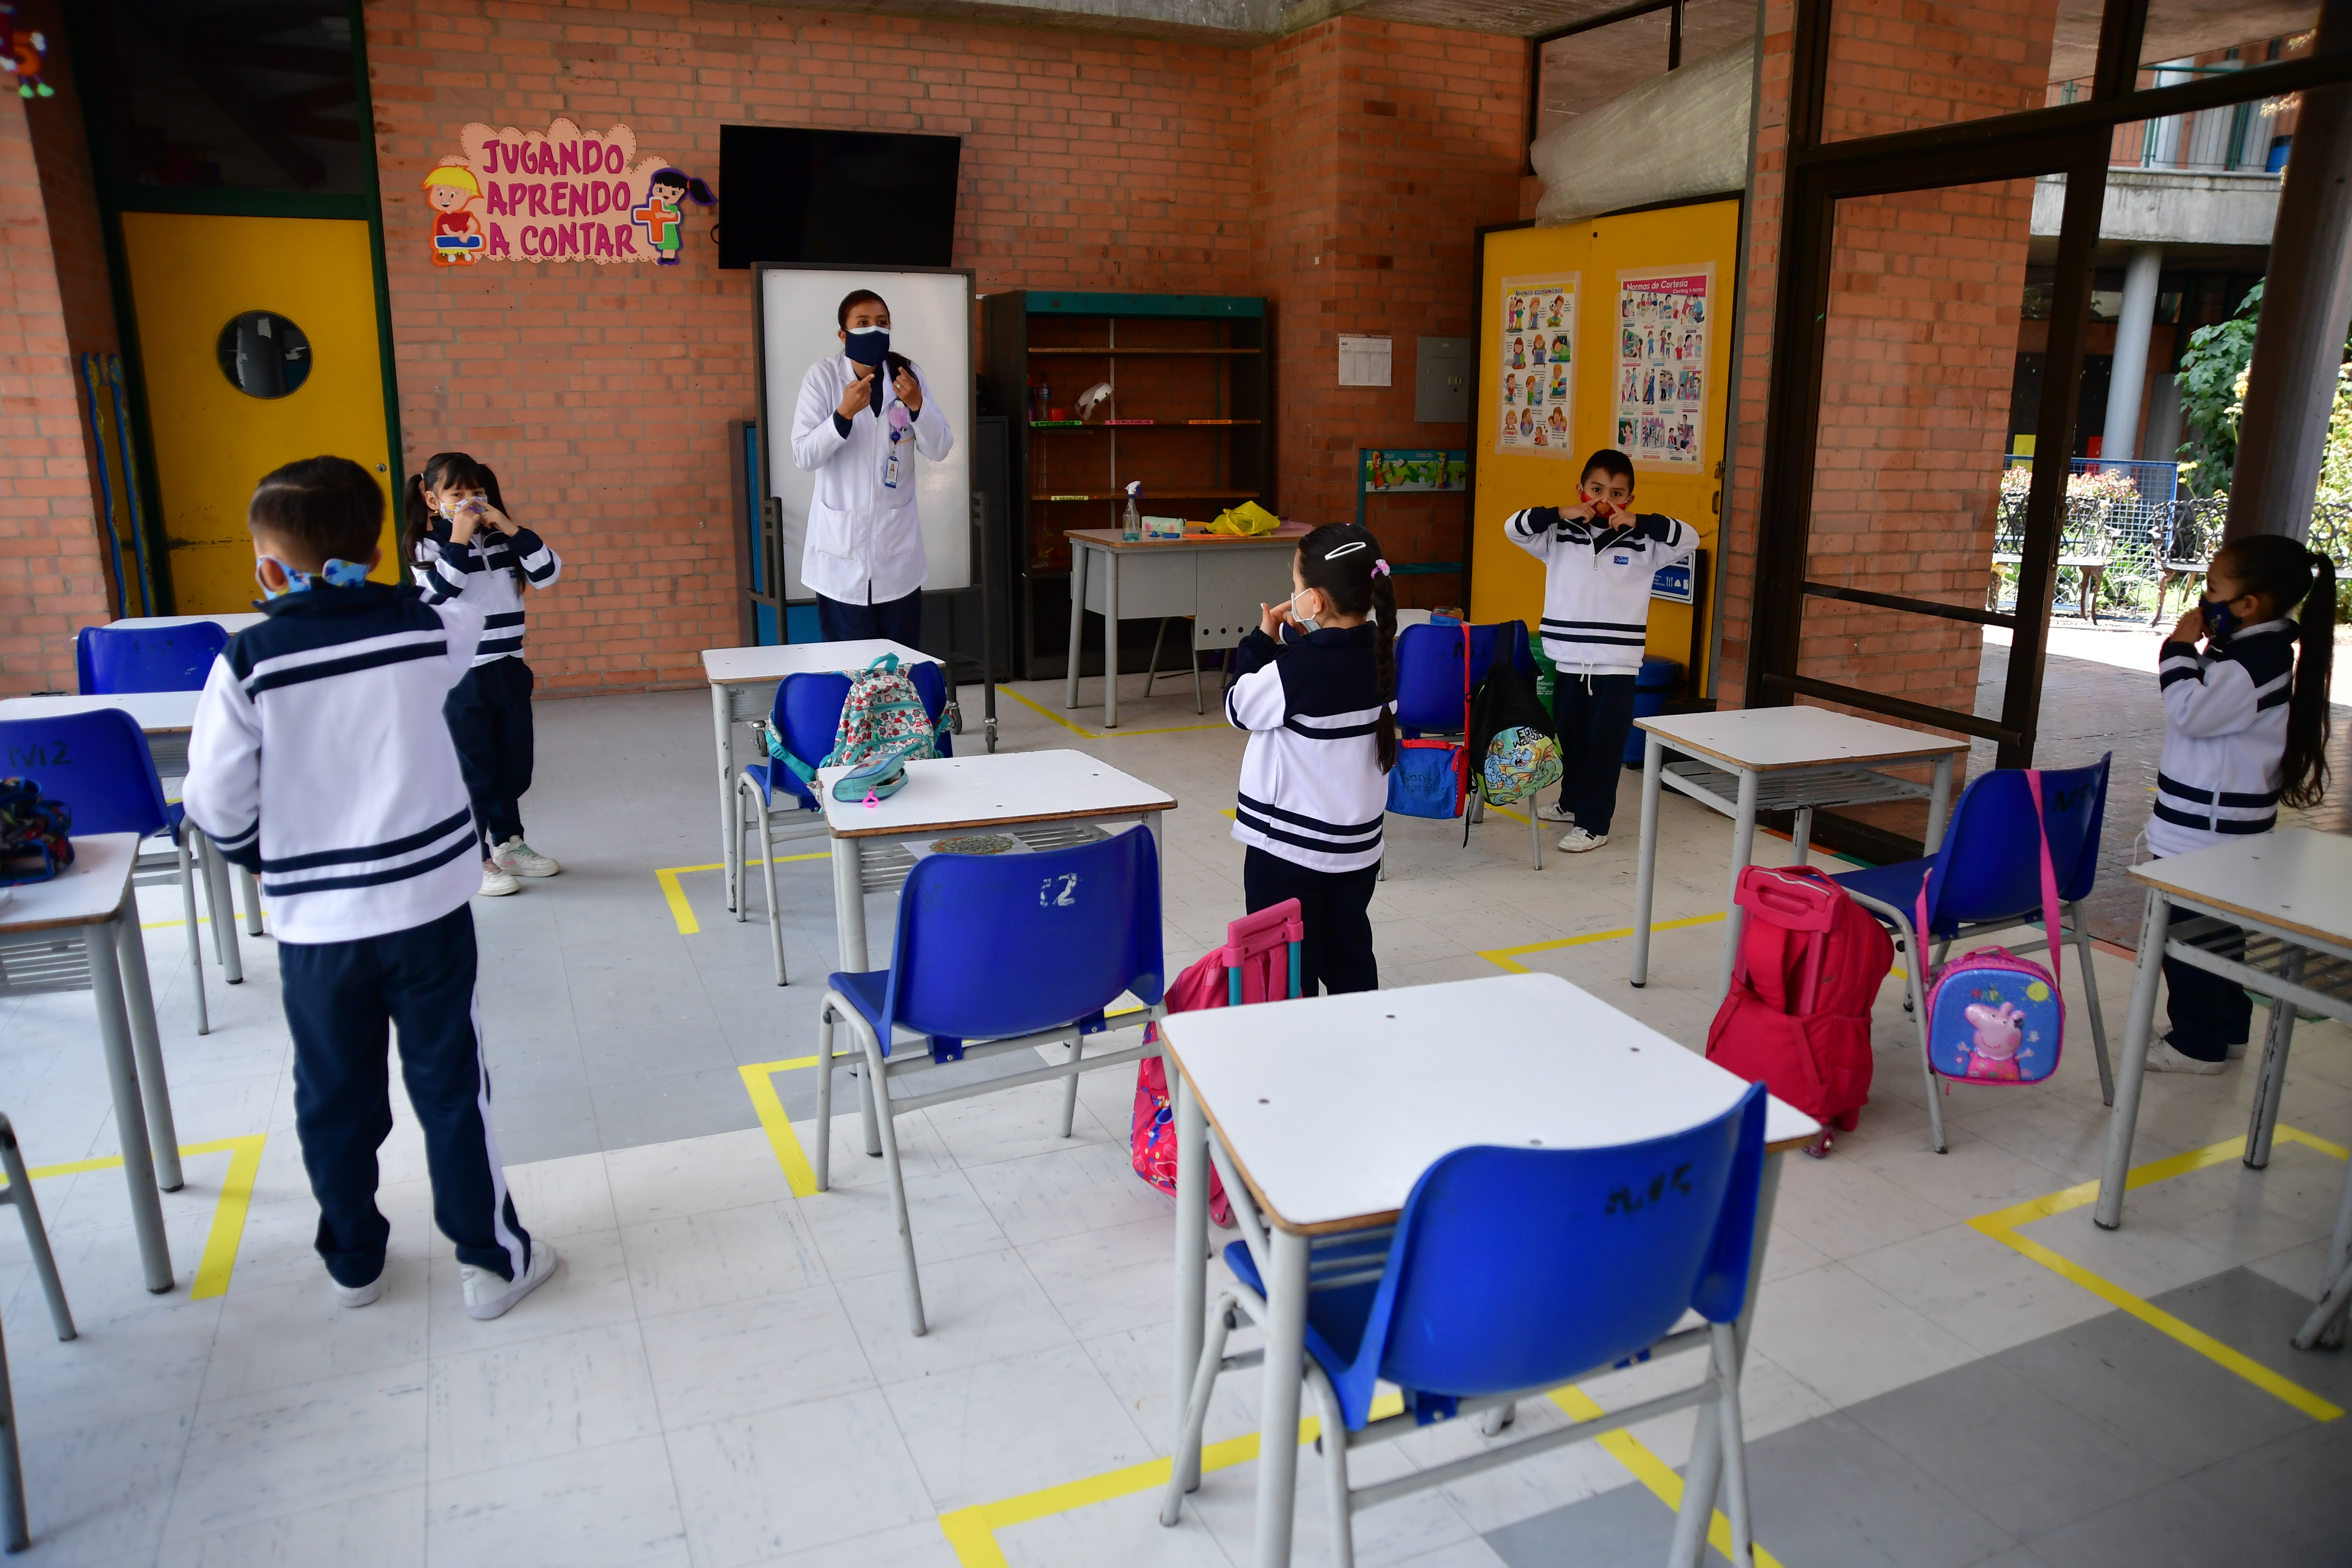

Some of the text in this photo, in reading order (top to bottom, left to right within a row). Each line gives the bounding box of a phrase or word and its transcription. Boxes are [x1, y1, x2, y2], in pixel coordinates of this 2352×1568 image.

[482, 139, 623, 176] JUGANDO
[486, 181, 631, 217] APRENDO
[490, 222, 637, 257] A CONTAR
[1627, 283, 1650, 291] Normas
[1652, 281, 1659, 289] de
